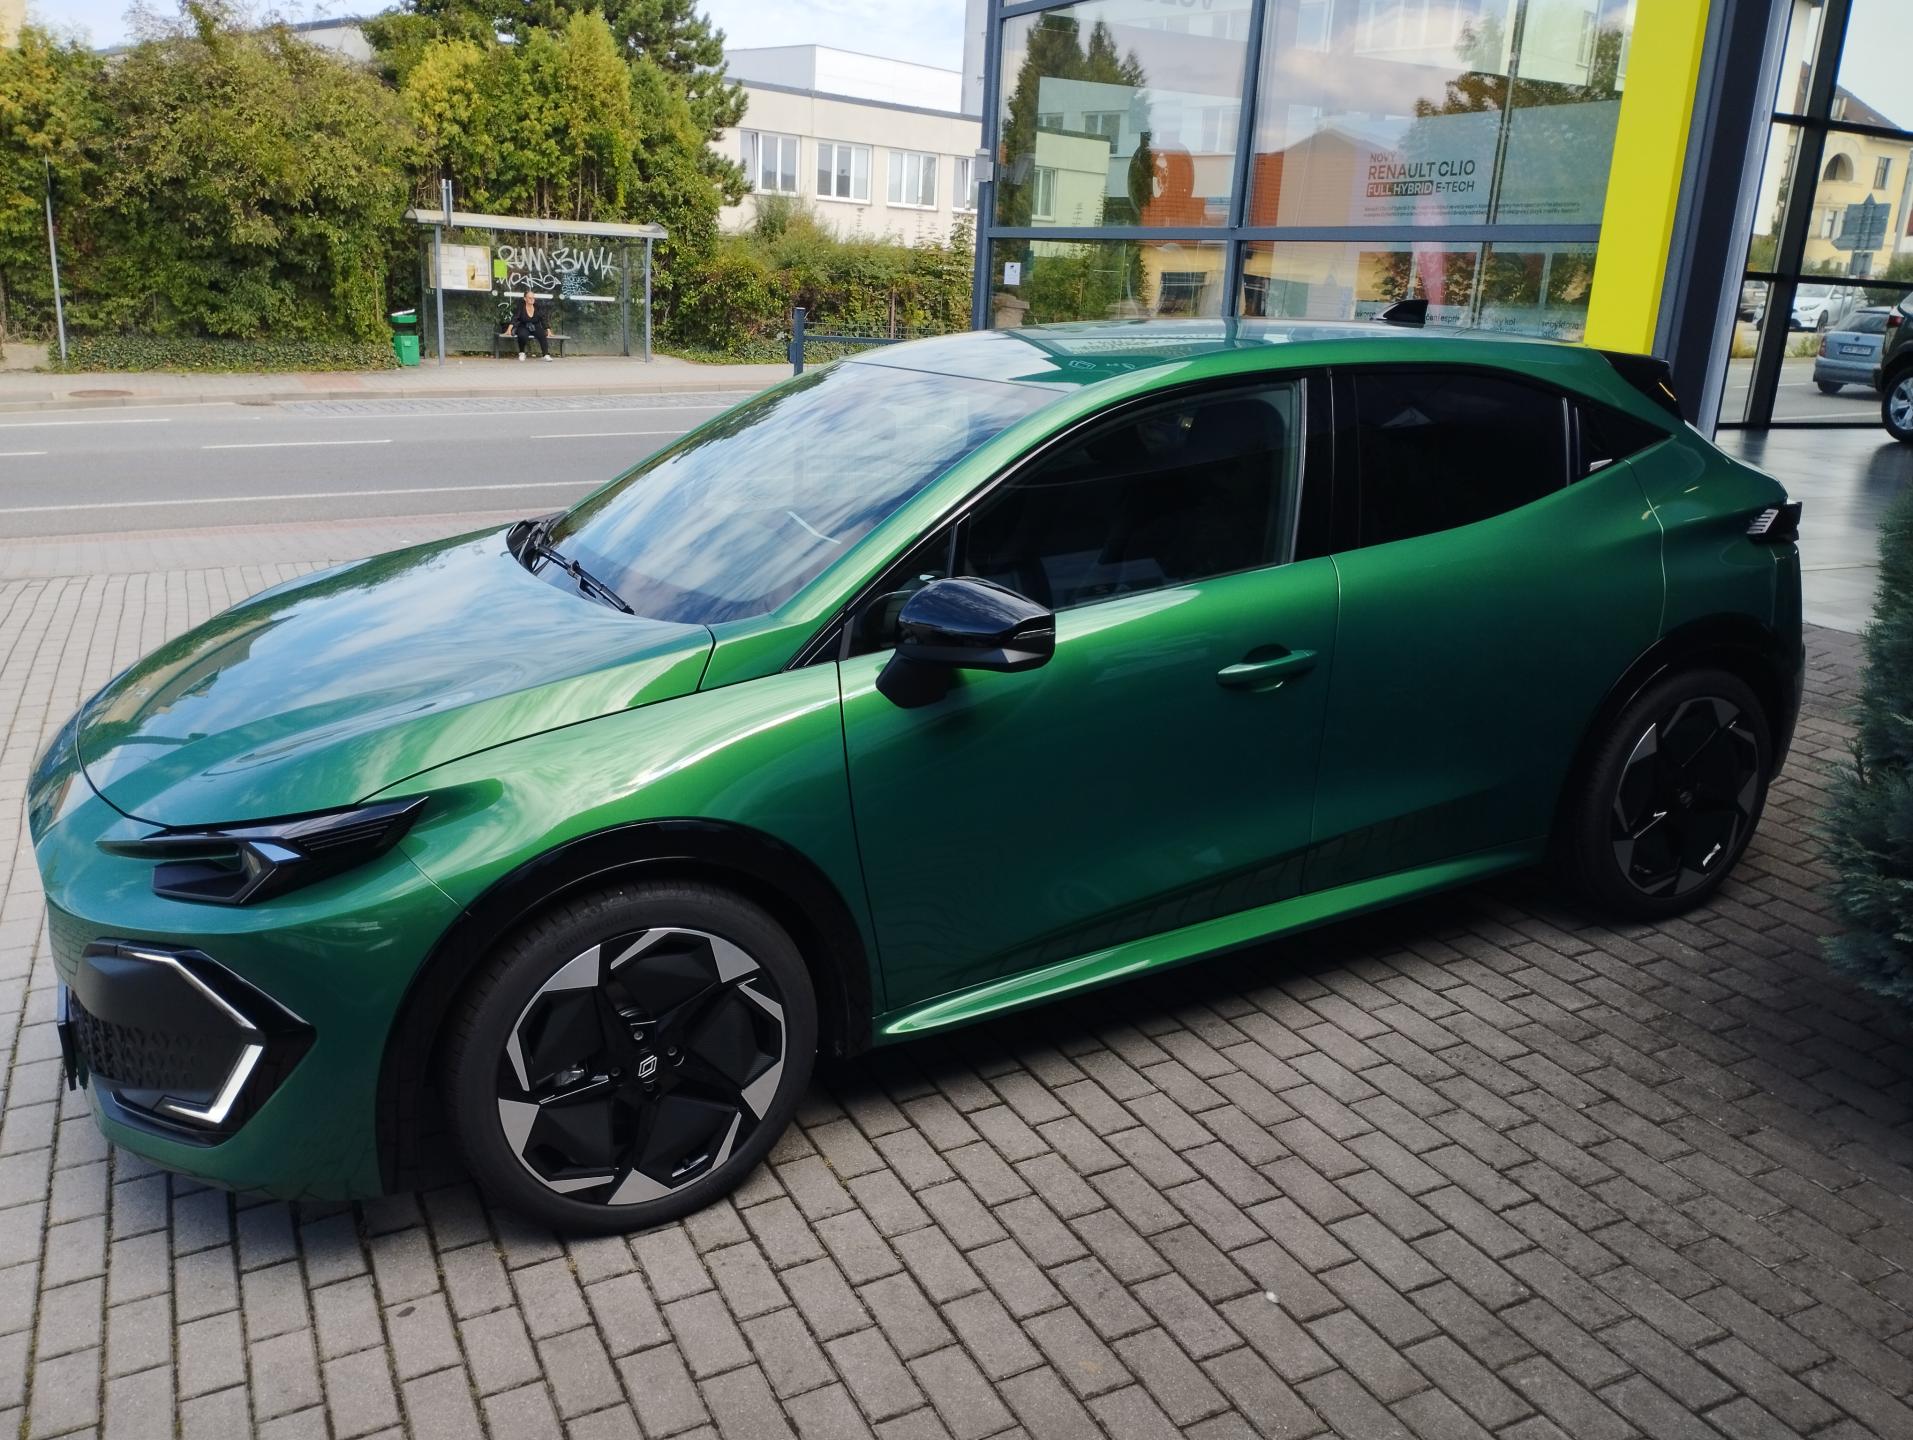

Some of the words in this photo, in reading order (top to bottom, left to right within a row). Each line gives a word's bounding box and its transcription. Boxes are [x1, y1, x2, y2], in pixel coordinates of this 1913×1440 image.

[1368, 162, 1436, 180] RENAULT
[1438, 159, 1475, 177] CLIO
[1368, 183, 1392, 196] FULL
[1393, 181, 1433, 195] HYBRID
[1436, 180, 1475, 193] E-TECH
